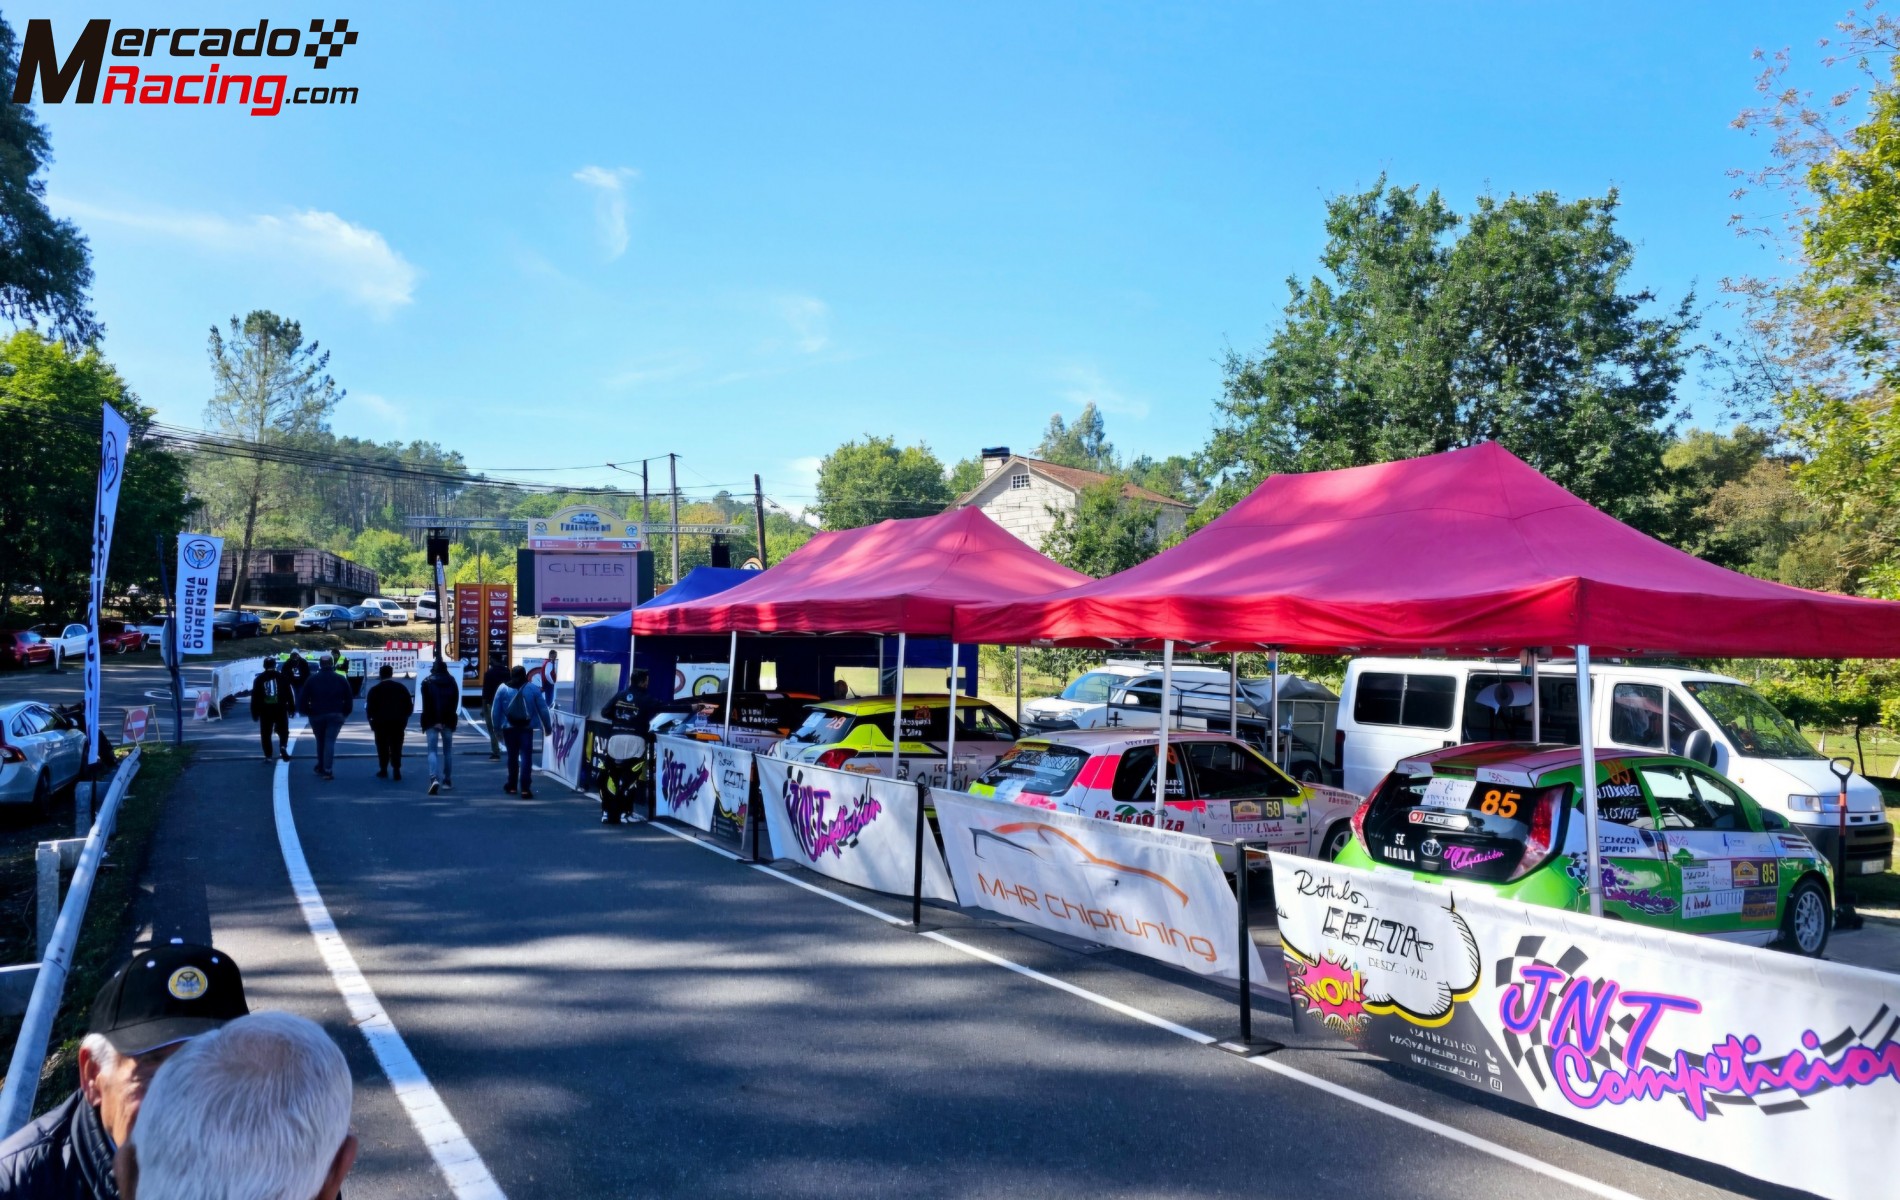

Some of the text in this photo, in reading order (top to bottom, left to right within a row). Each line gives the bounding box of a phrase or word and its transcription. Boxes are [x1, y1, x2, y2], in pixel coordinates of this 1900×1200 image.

[549, 563, 624, 576] CUTTER
[193, 577, 208, 649] OURENSE
[826, 715, 847, 730] 28
[1480, 789, 1521, 819] 85
[977, 872, 1217, 962] MHR Chiptuning
[1321, 905, 1434, 962] CELTA
[1500, 965, 1703, 1070] JNT
